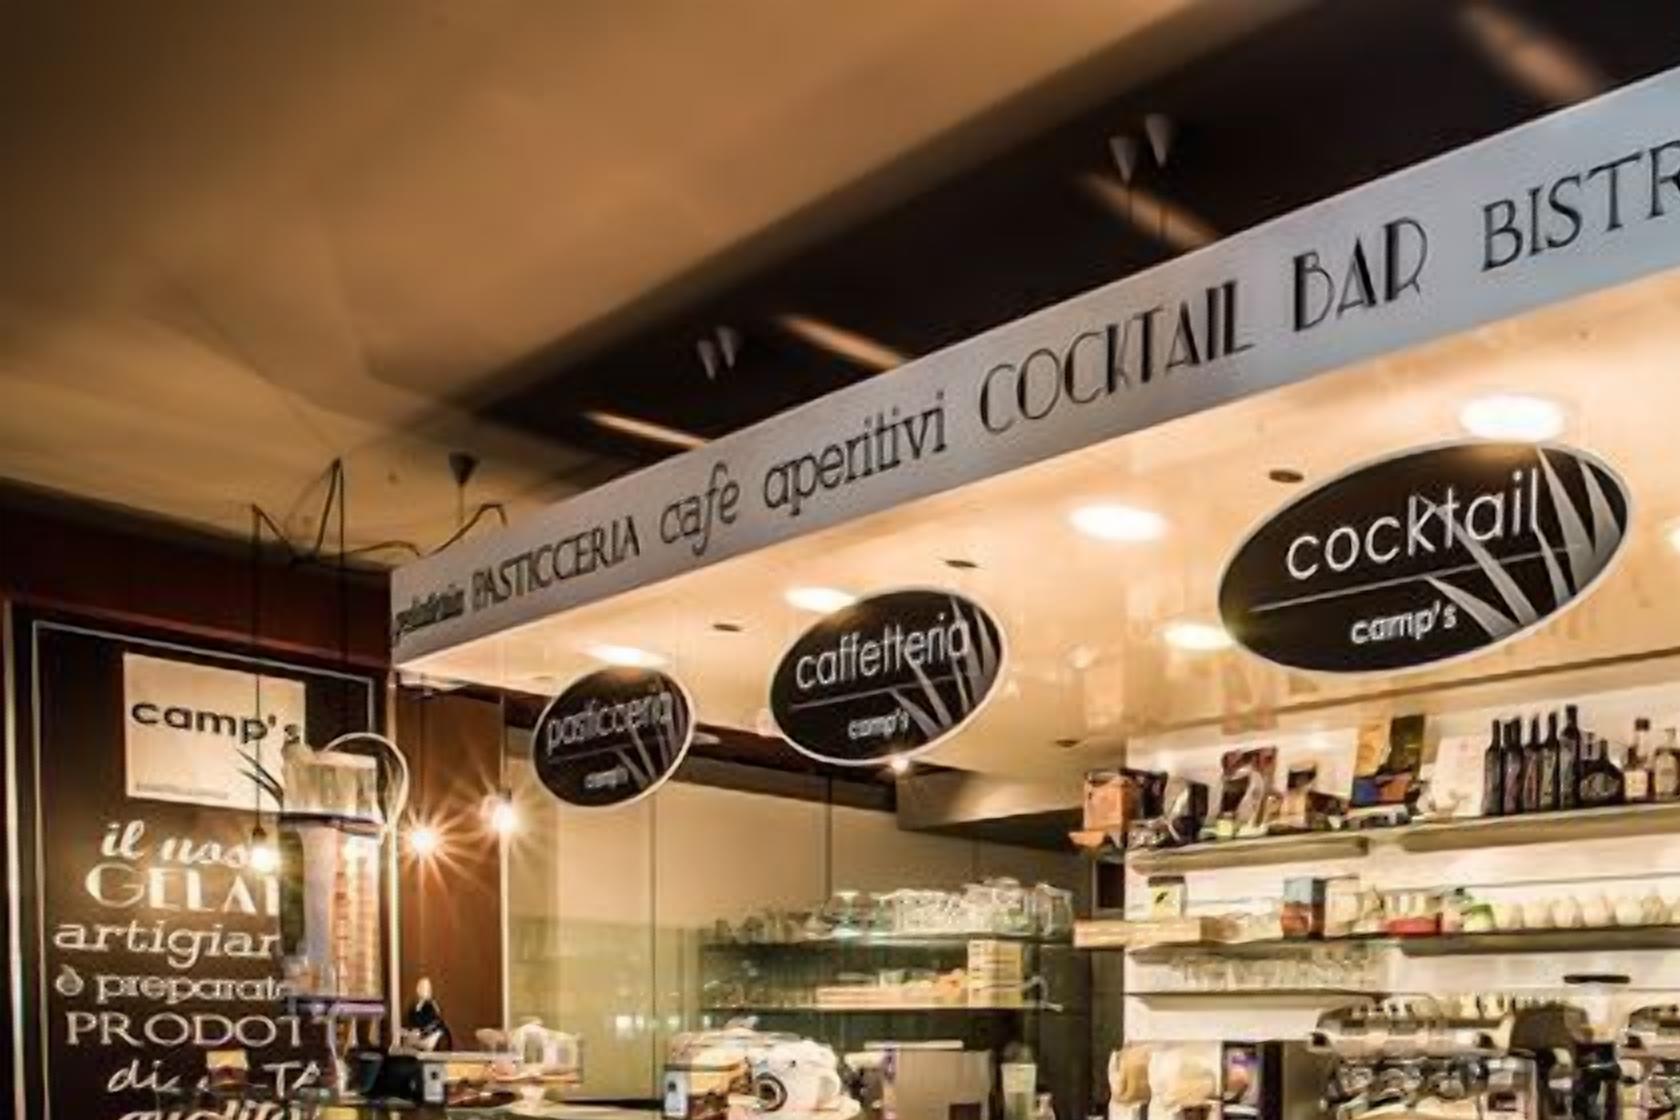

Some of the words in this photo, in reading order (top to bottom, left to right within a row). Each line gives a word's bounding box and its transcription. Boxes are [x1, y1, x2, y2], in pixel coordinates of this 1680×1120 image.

[472, 514, 641, 612] PASTICCERIA
[763, 390, 947, 516] aperitivi
[978, 279, 1255, 436] COCKTAIL
[1292, 217, 1430, 333] BAR
[1286, 467, 1541, 580] cocktail
[1350, 602, 1457, 645] camp's
[797, 612, 969, 689] caffetteria
[131, 702, 300, 745] camp's
[101, 820, 147, 861] il
[107, 1059, 182, 1093] di
